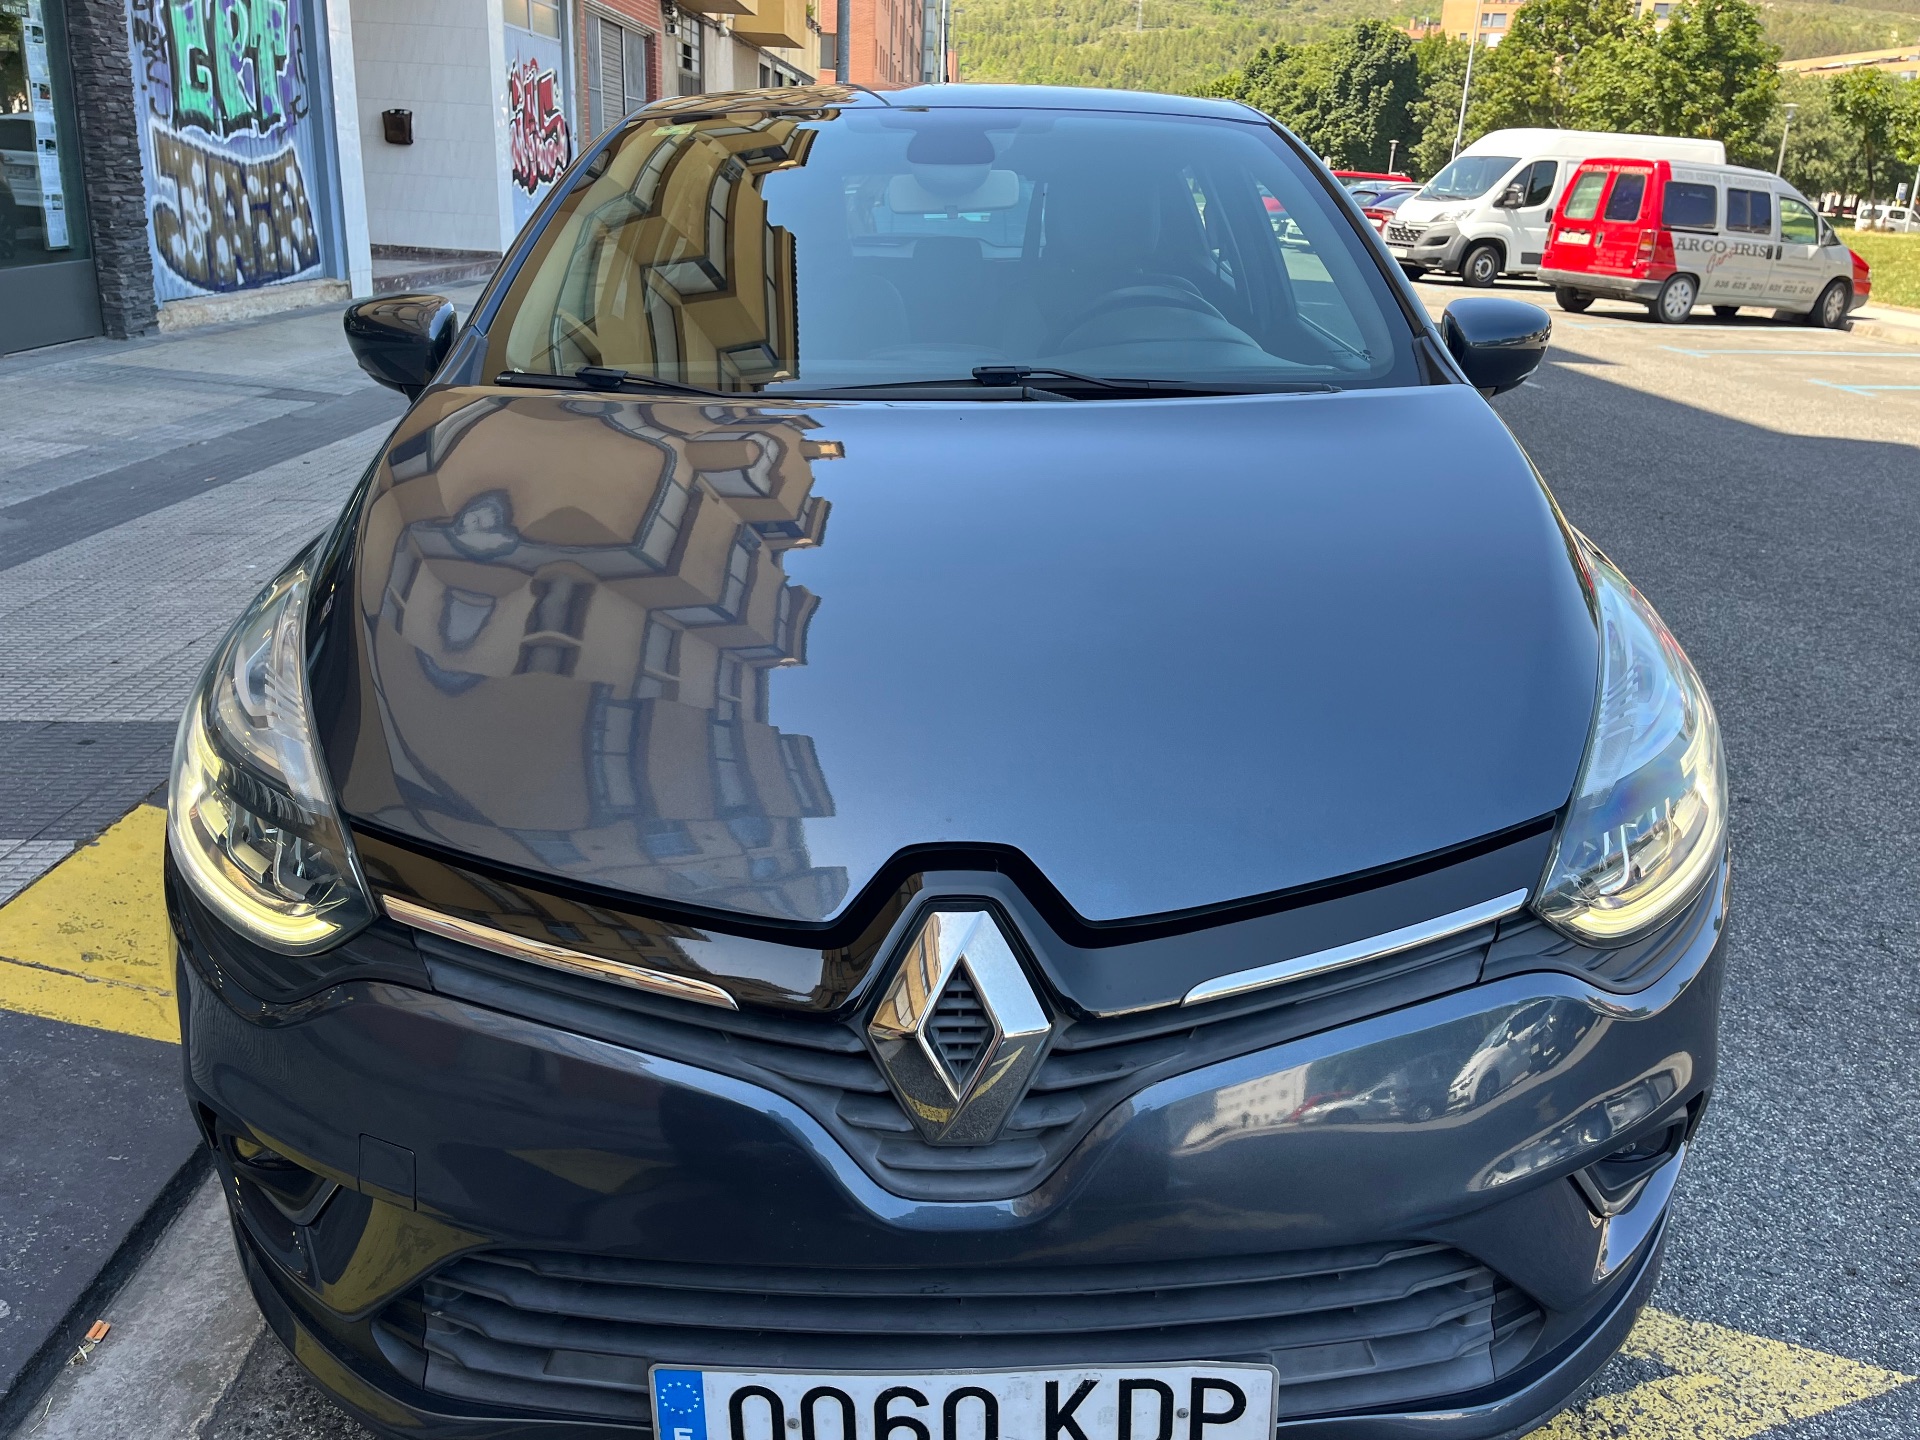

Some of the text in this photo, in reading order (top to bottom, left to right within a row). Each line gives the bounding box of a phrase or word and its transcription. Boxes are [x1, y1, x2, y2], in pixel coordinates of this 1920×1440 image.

[1675, 237, 1767, 258] ARCO IRIS
[729, 1377, 1247, 1440] 0060 KDP
